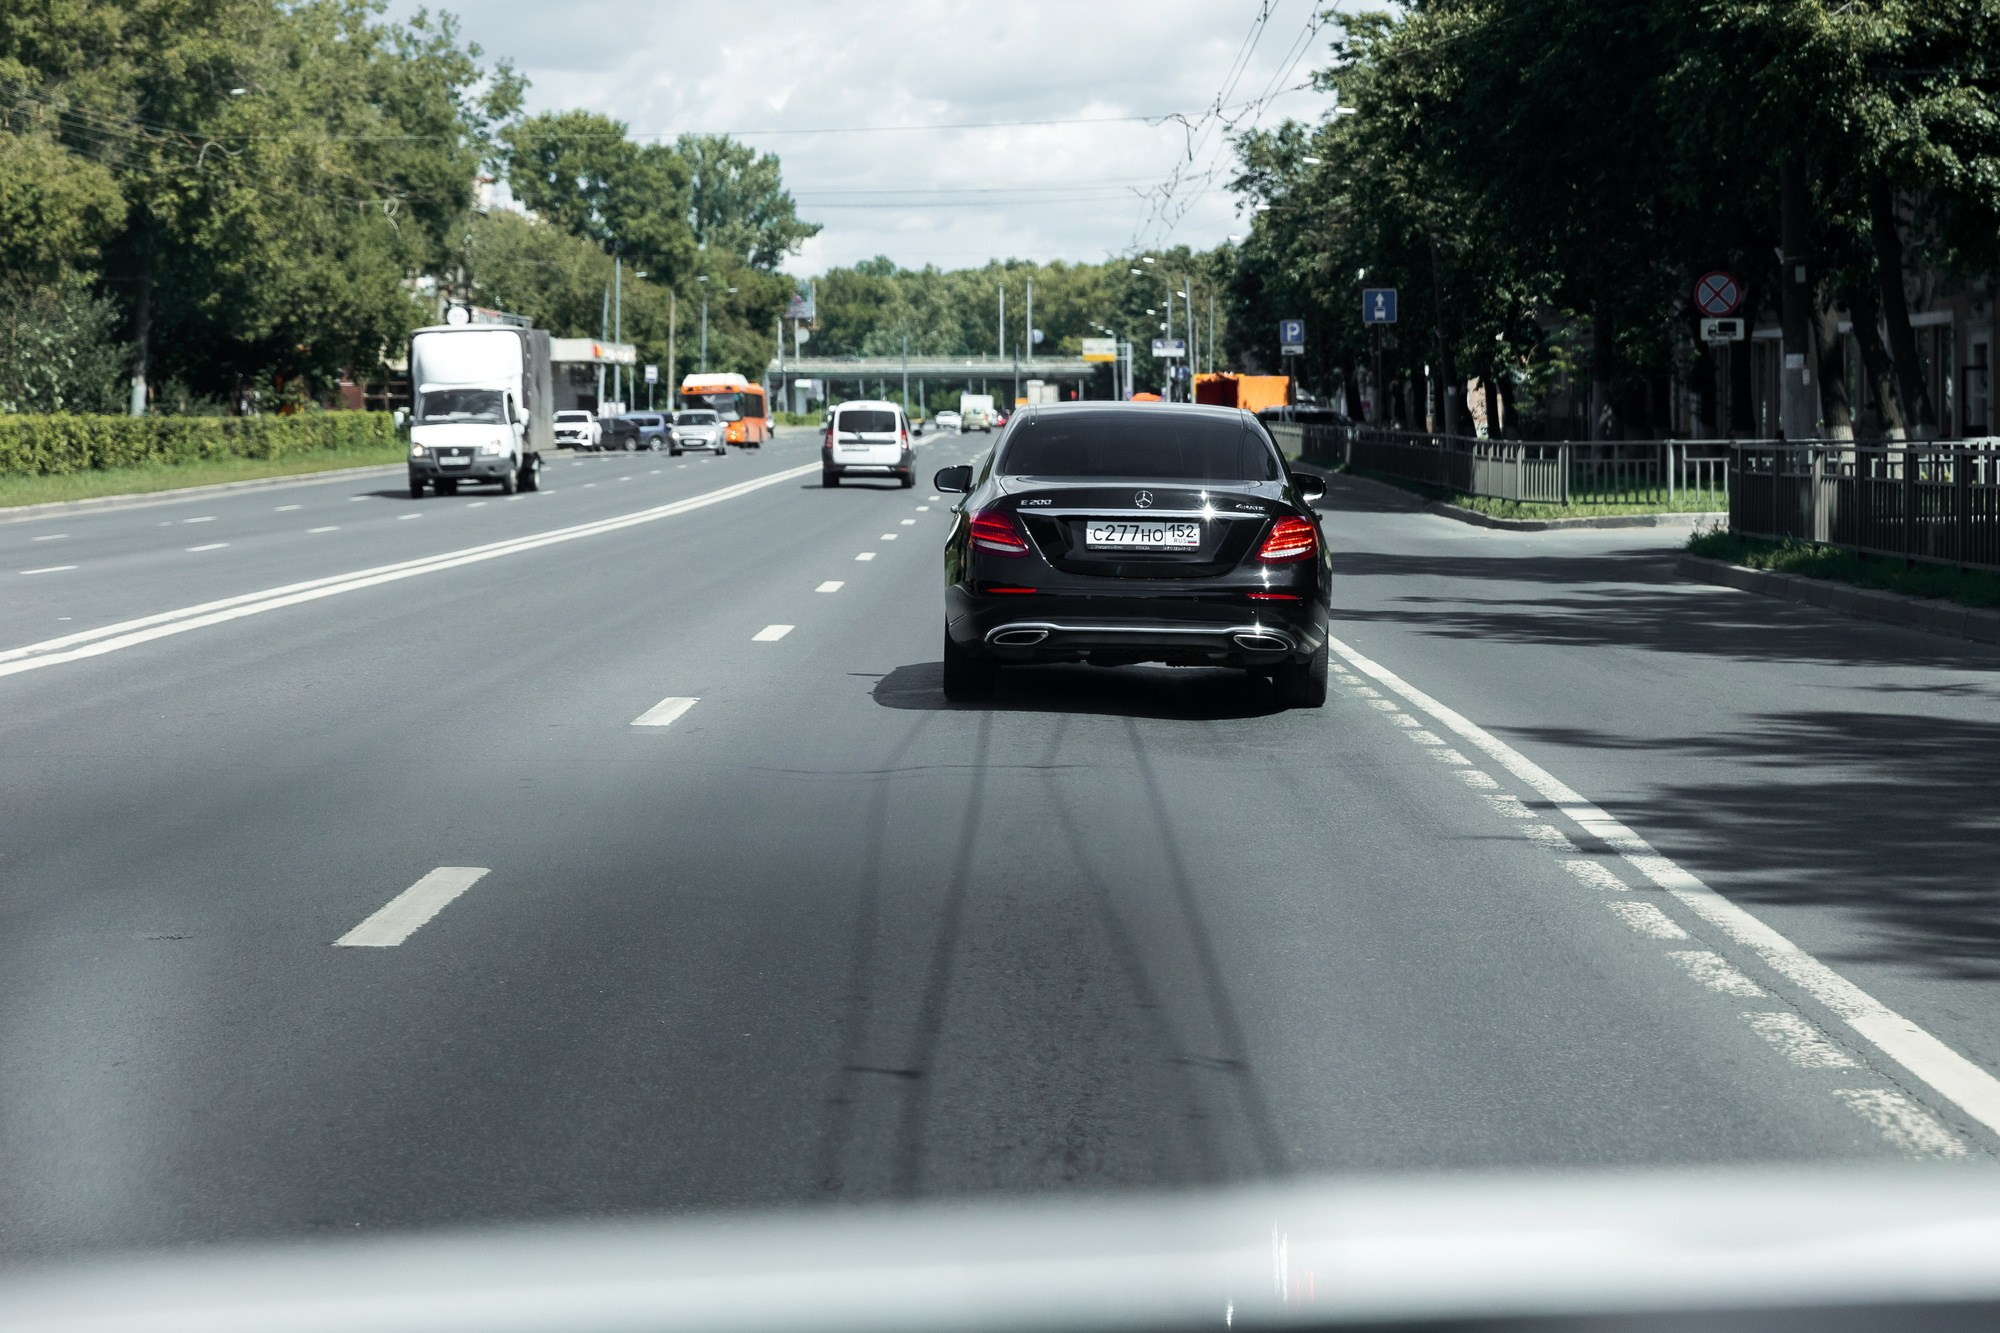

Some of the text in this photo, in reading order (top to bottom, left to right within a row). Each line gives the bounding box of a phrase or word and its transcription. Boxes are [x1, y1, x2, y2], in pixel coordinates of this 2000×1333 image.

[1287, 322, 1299, 342] P
[1093, 524, 1194, 542] С277НО 152
